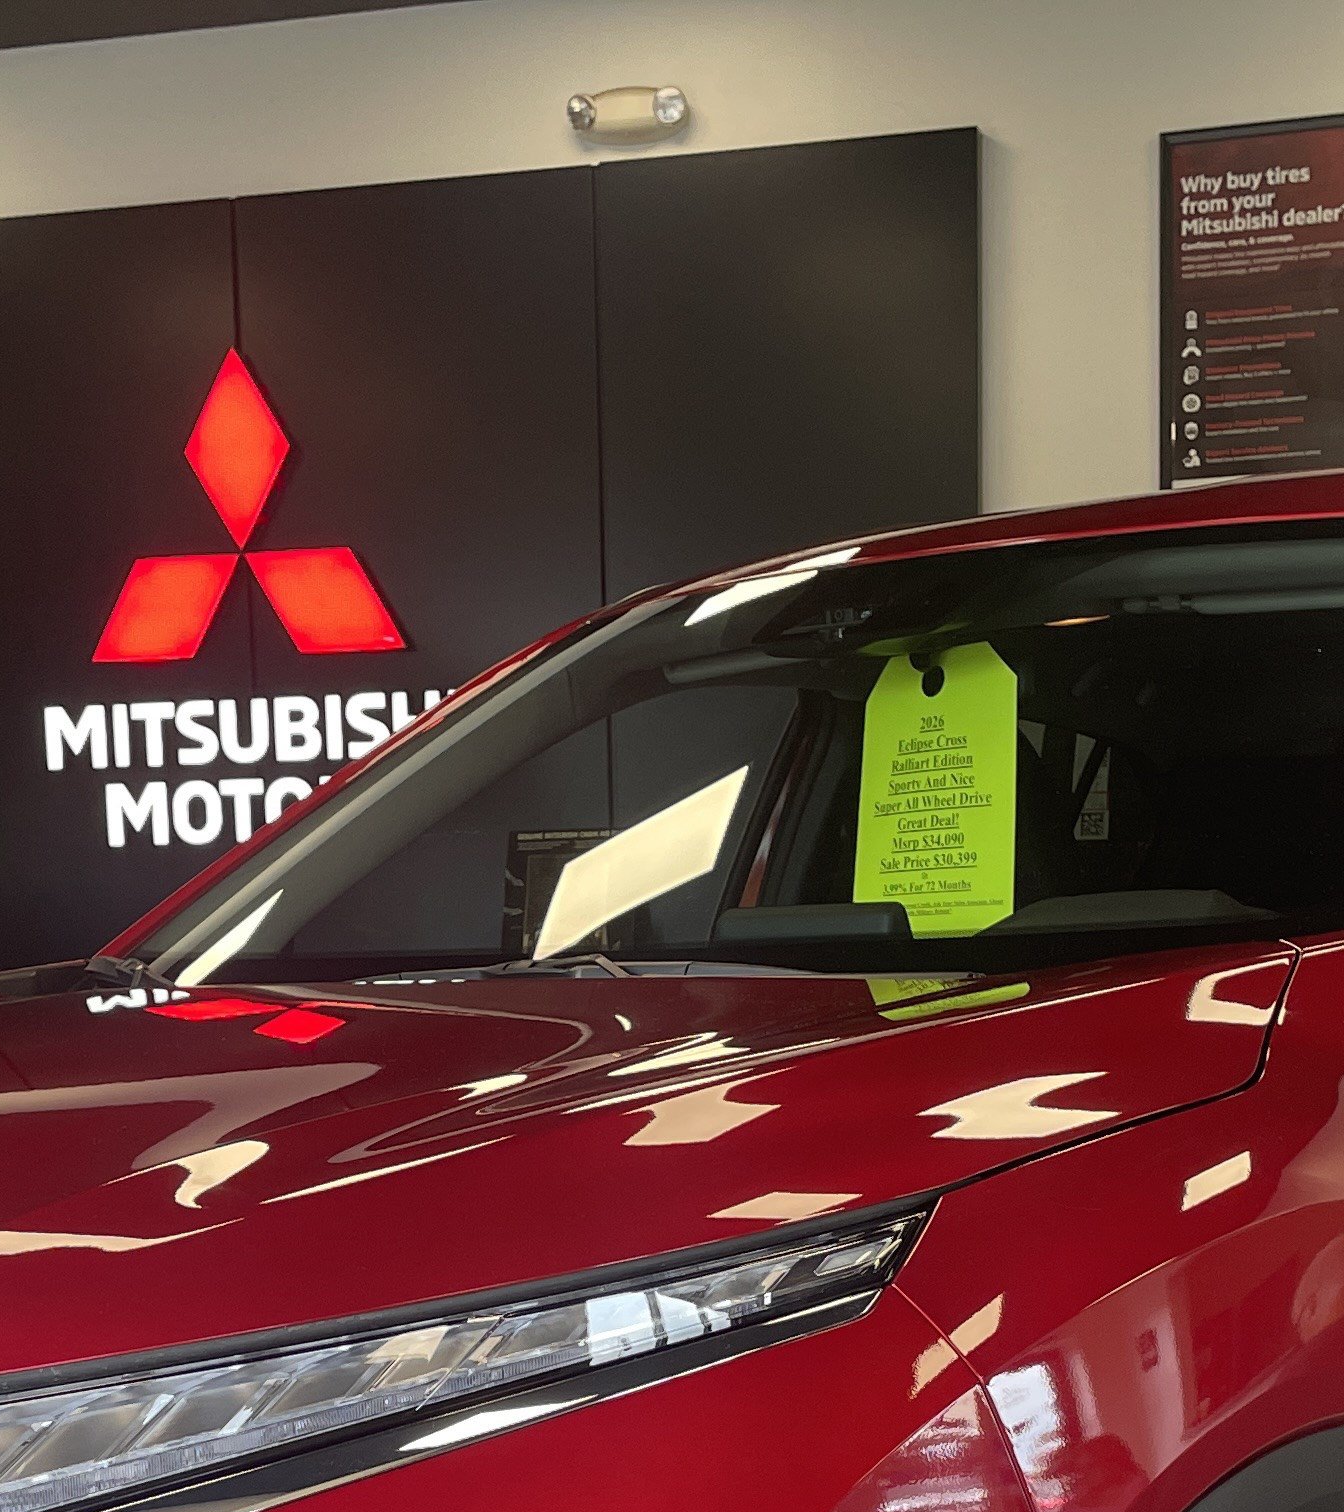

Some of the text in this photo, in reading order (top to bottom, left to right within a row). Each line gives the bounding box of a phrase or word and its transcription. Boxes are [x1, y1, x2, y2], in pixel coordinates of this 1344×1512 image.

[1180, 166, 1311, 195] Why buy tires
[1180, 192, 1276, 215] from your
[1181, 209, 1279, 237] Mitsubishi
[43, 689, 457, 771] MITSUBISH
[919, 715, 945, 730] 2026
[898, 734, 967, 753] Eclipse Cross
[892, 753, 973, 773] Ralliart Edition
[888, 772, 975, 794] Sporty And Nice
[105, 774, 330, 848] MOTO
[874, 791, 992, 815] Super All Wheel Drive
[897, 817, 927, 831] Great
[892, 837, 919, 851] Msrp
[880, 858, 900, 870] Sale
[903, 855, 931, 869] Price
[909, 882, 924, 892] For
[925, 881, 935, 890] 72
[938, 880, 972, 890] Months
